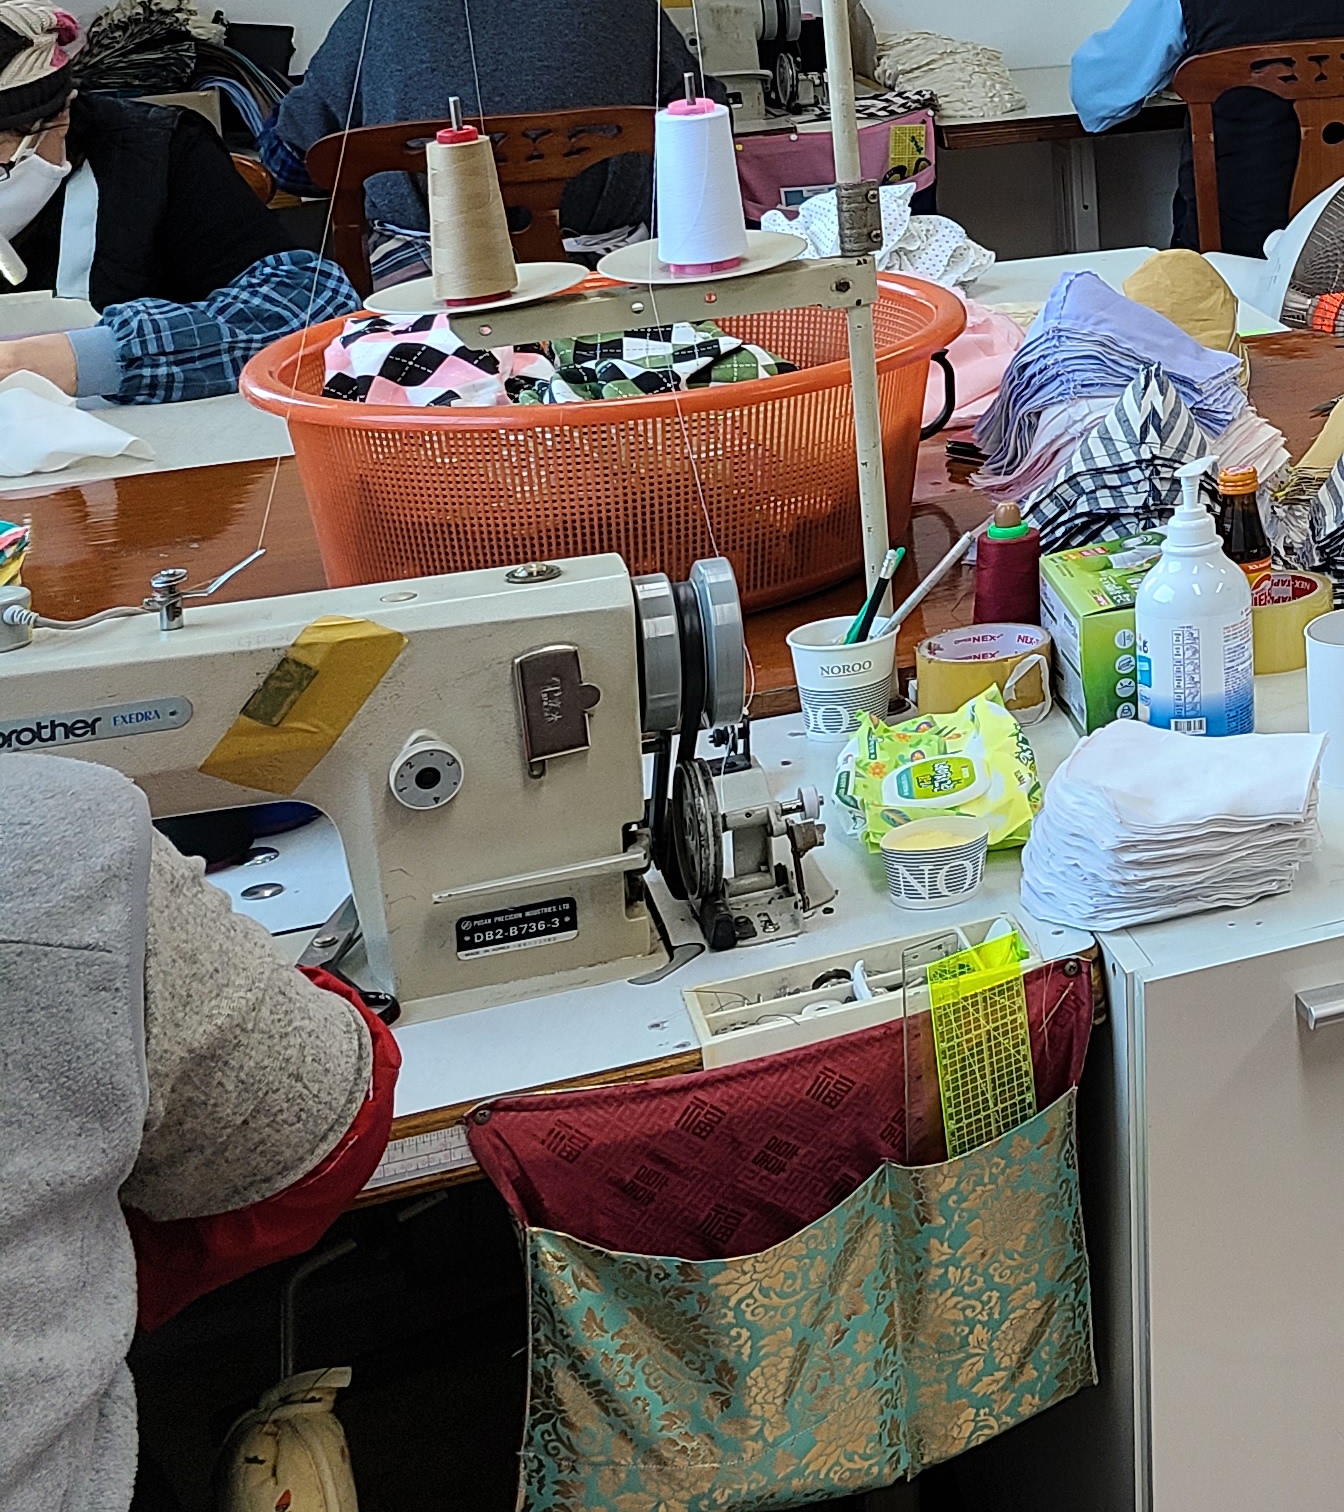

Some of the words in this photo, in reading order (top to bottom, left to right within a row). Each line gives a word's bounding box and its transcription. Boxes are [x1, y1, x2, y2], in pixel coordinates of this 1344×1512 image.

[820, 660, 873, 676] NOROO
[113, 709, 161, 726] EXEDRA
[405, 761, 415, 771] 2
[446, 758, 456, 768] 3
[432, 795, 441, 805] 4
[494, 912, 523, 923] PRECISION
[525, 905, 557, 917] INDUSTRIES
[474, 917, 560, 943] DB2-B736-3
